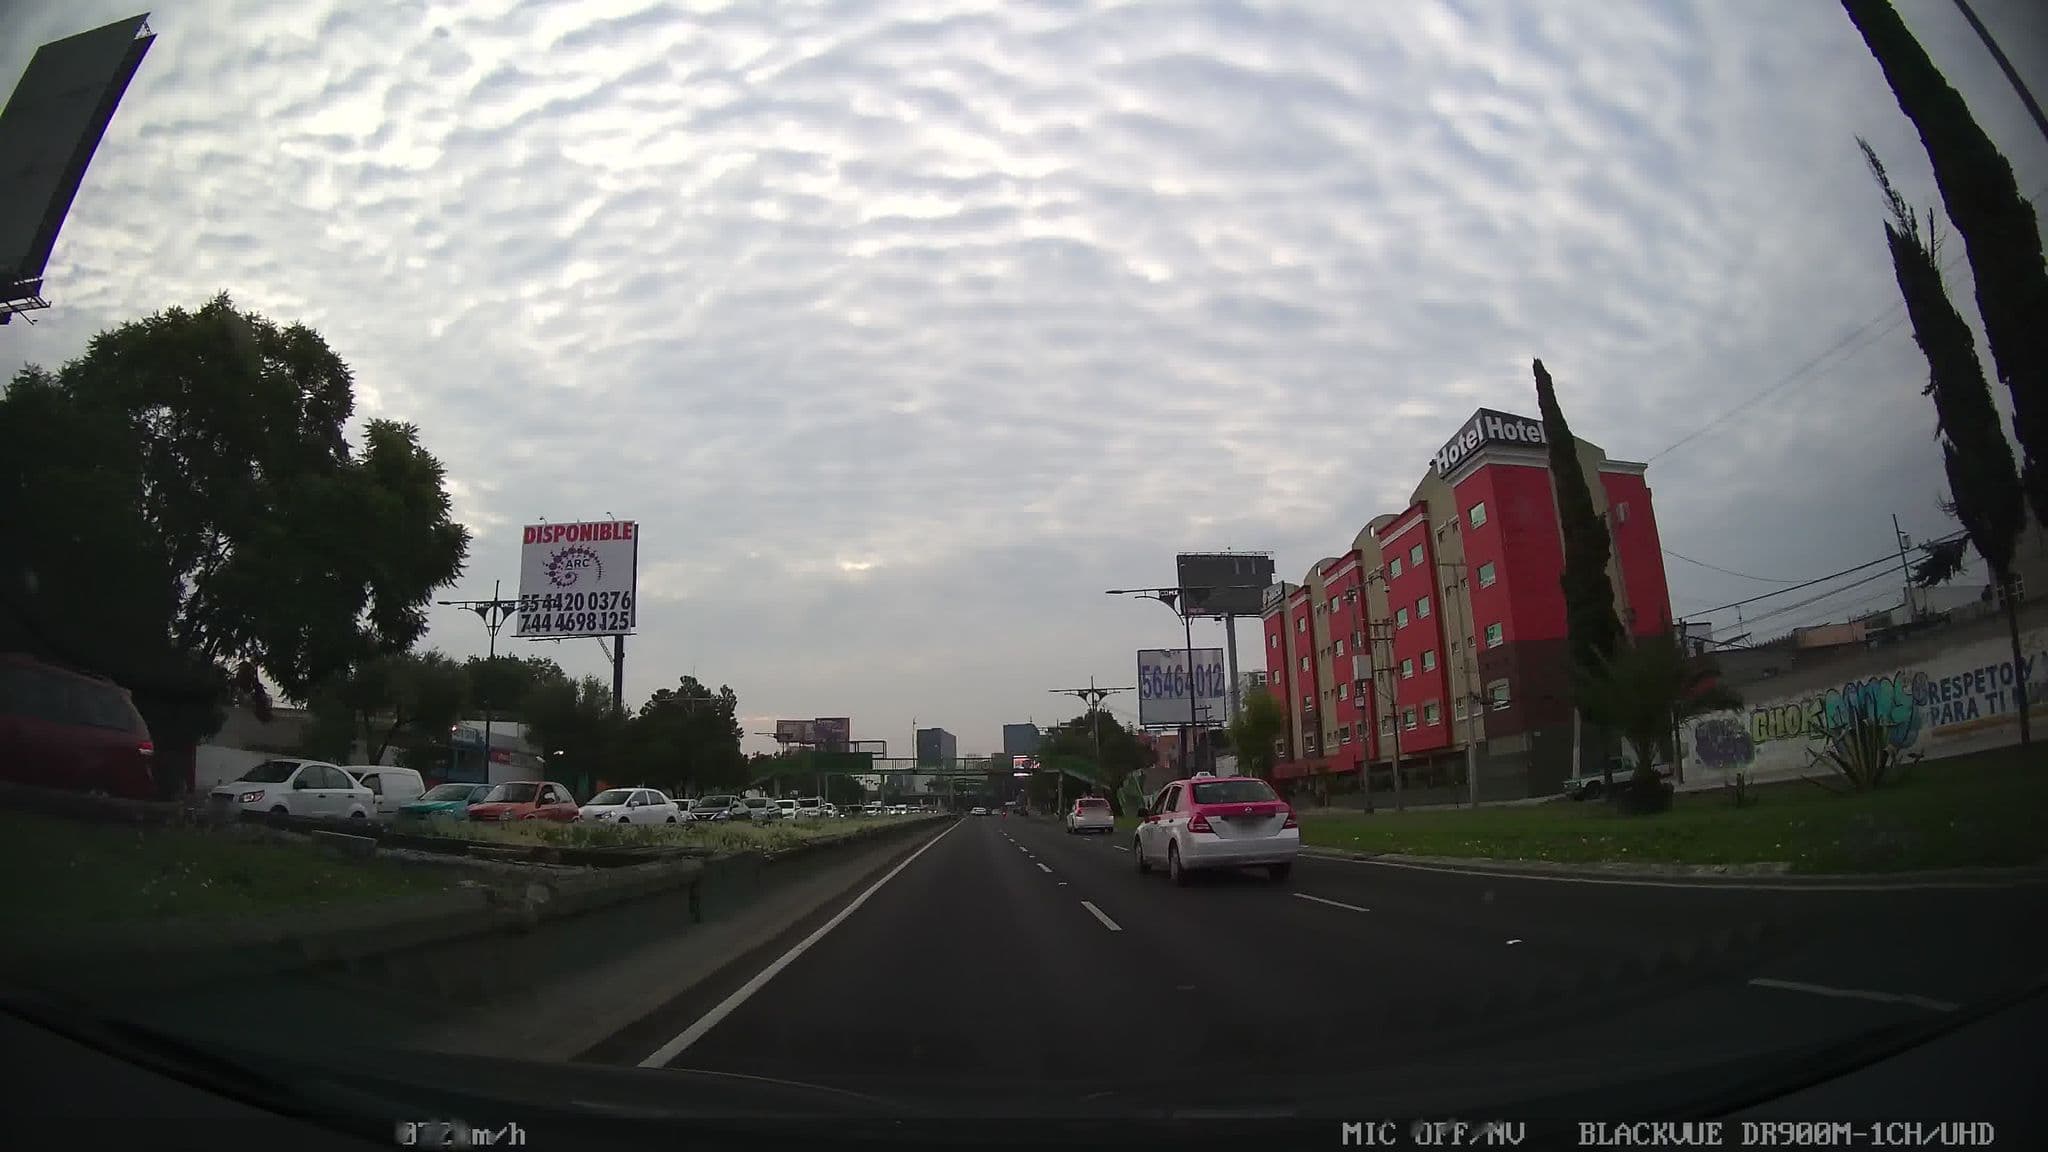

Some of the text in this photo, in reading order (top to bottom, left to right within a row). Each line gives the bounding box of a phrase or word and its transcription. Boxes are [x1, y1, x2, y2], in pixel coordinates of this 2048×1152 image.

[1484, 416, 1547, 444] Hotel
[1436, 418, 1484, 475] Hotel
[523, 523, 633, 544] DISPONIBLE
[565, 558, 590, 569] ARC
[1927, 662, 2014, 705] RESPETO
[1929, 698, 1979, 726] PARA
